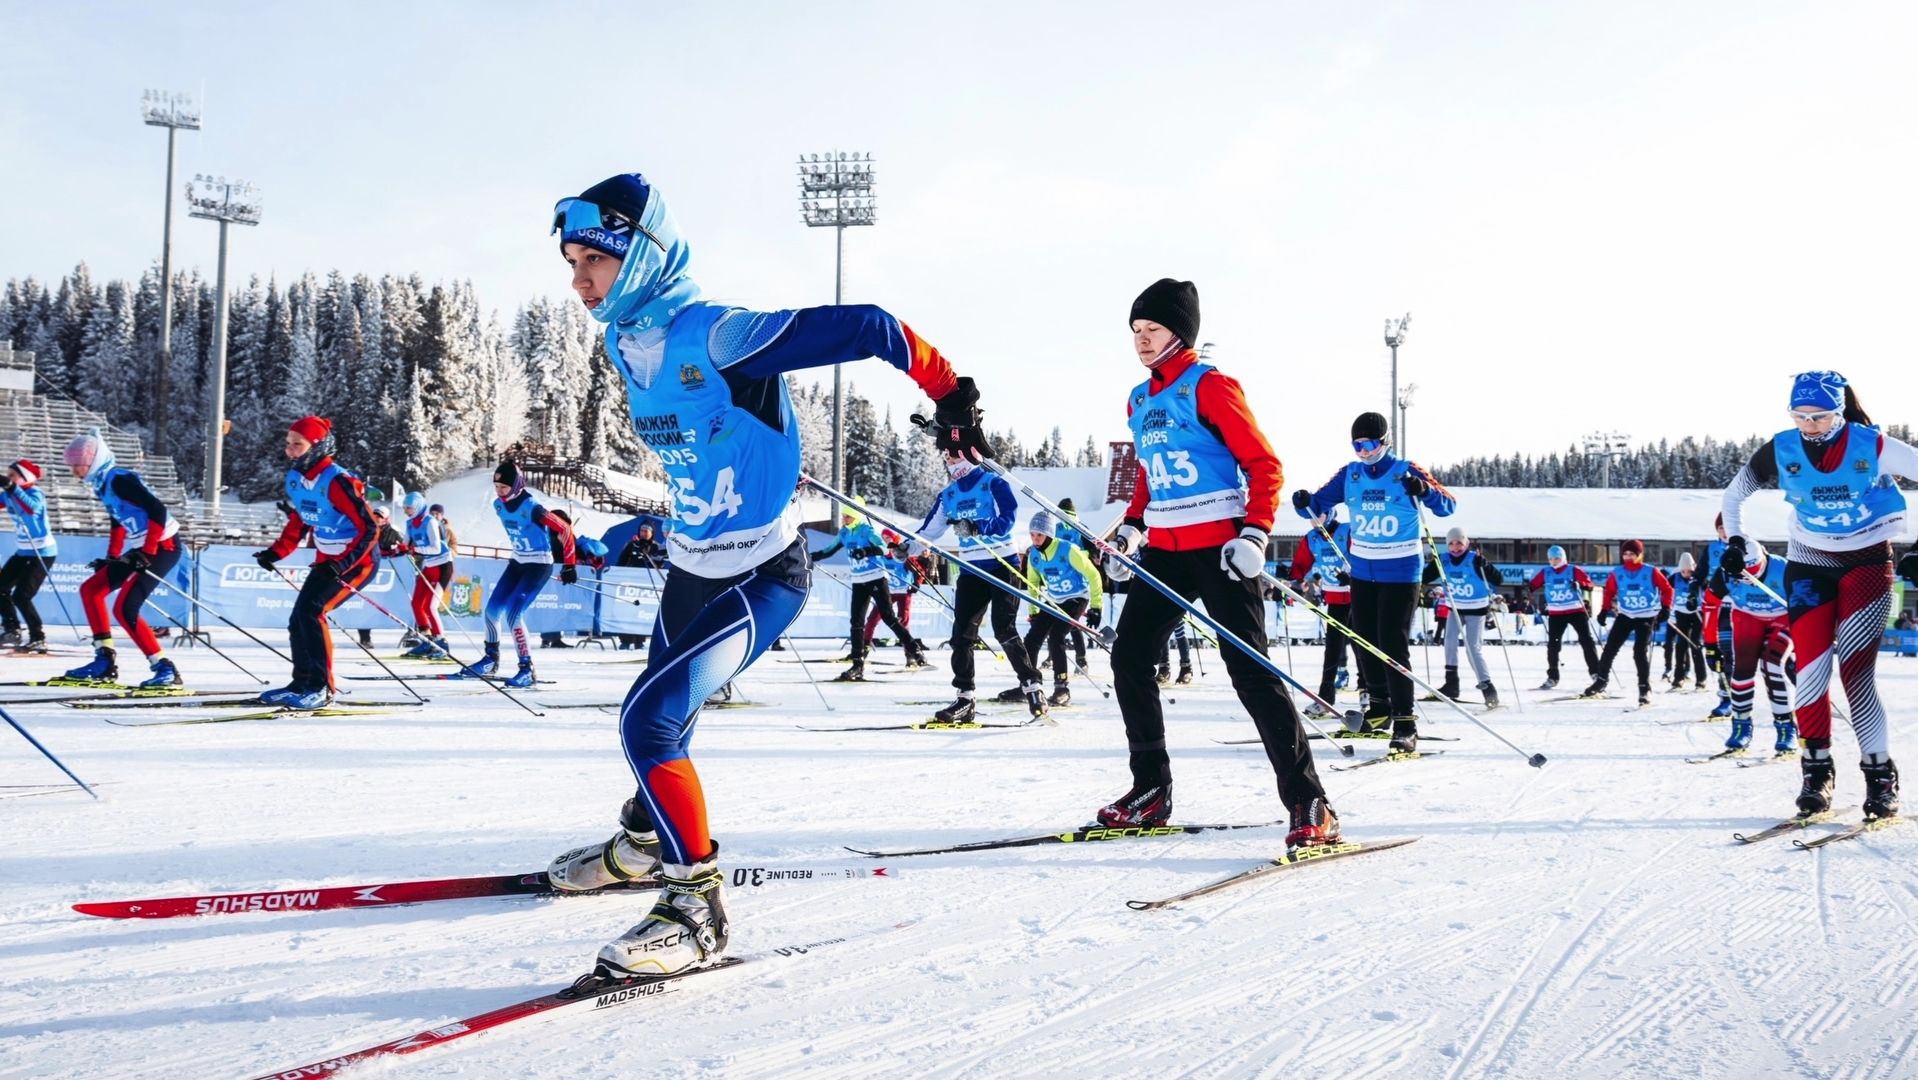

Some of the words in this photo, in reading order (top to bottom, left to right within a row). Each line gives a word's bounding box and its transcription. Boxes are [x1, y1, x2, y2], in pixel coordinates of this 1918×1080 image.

[576, 228, 629, 252] UGRASK
[635, 414, 679, 432] ЛЫЖНЯ
[1141, 430, 1168, 449] 2025
[659, 447, 698, 467] 025
[668, 465, 743, 526] 54
[1816, 501, 1855, 509] 2025
[1361, 502, 1386, 511] 2025
[1355, 514, 1399, 538] 240
[1550, 590, 1574, 602] 266
[1623, 596, 1649, 609] 238
[513, 627, 528, 657] RUSS
[926, 723, 983, 731] FISCHER
[1085, 825, 1184, 842] FISCHER
[1296, 843, 1361, 862] FISCHER
[733, 868, 765, 887] 3.0
[766, 870, 813, 880] REDLINE
[194, 891, 320, 914] MADSHUS
[627, 917, 715, 956] FISCHR
[596, 982, 666, 1008] MADSHUS
